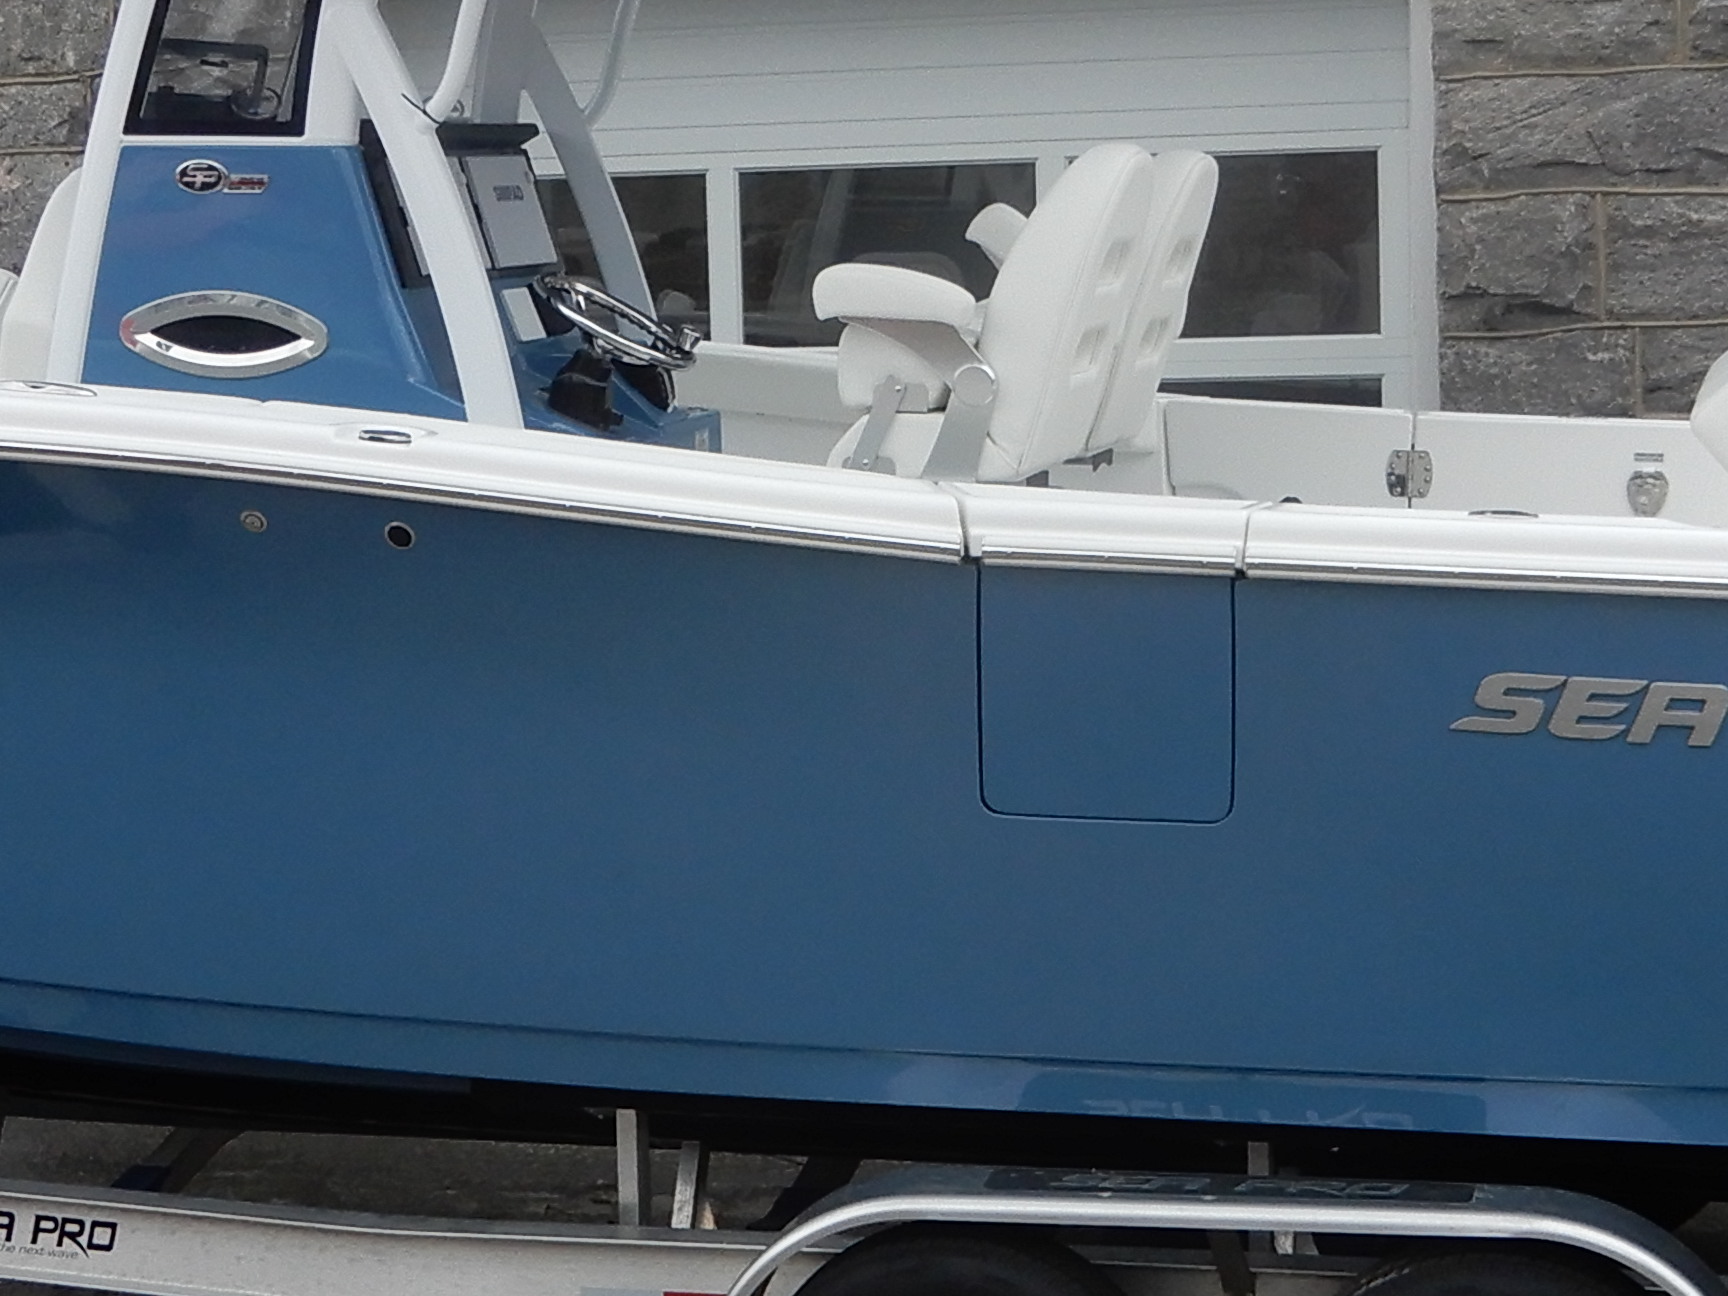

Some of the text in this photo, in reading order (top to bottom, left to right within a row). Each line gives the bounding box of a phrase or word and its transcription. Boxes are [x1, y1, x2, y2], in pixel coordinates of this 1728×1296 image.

[30, 1213, 119, 1259] PRO
[18, 1244, 45, 1257] next
[47, 1249, 79, 1261] wave
